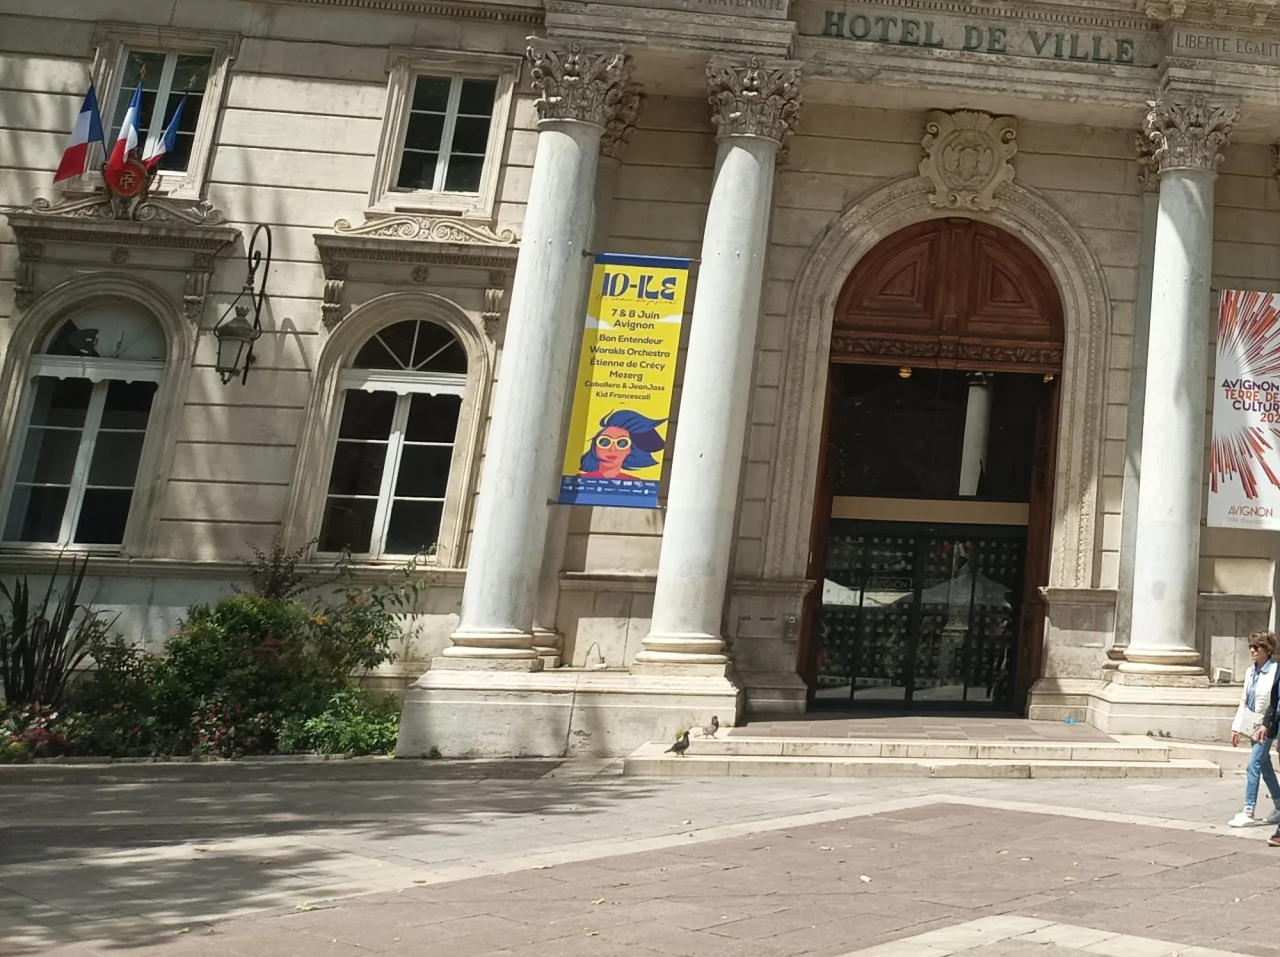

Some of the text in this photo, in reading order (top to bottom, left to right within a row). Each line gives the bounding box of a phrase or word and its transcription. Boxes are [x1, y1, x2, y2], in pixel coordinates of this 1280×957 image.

[822, 10, 1134, 63] HOTEL DE VILLE
[611, 308, 660, 320] 7 & 8 Juin
[613, 319, 654, 331] Avignon
[599, 334, 664, 345] Bon Entendeur
[626, 347, 671, 358] Orchestra
[589, 355, 624, 367] Étienne
[639, 360, 666, 371] Crécy
[609, 370, 643, 382] Mezerg
[1221, 378, 1280, 392] AVIGNON
[1224, 388, 1280, 403] TERRE DE
[1227, 505, 1273, 517] AVIGNON
